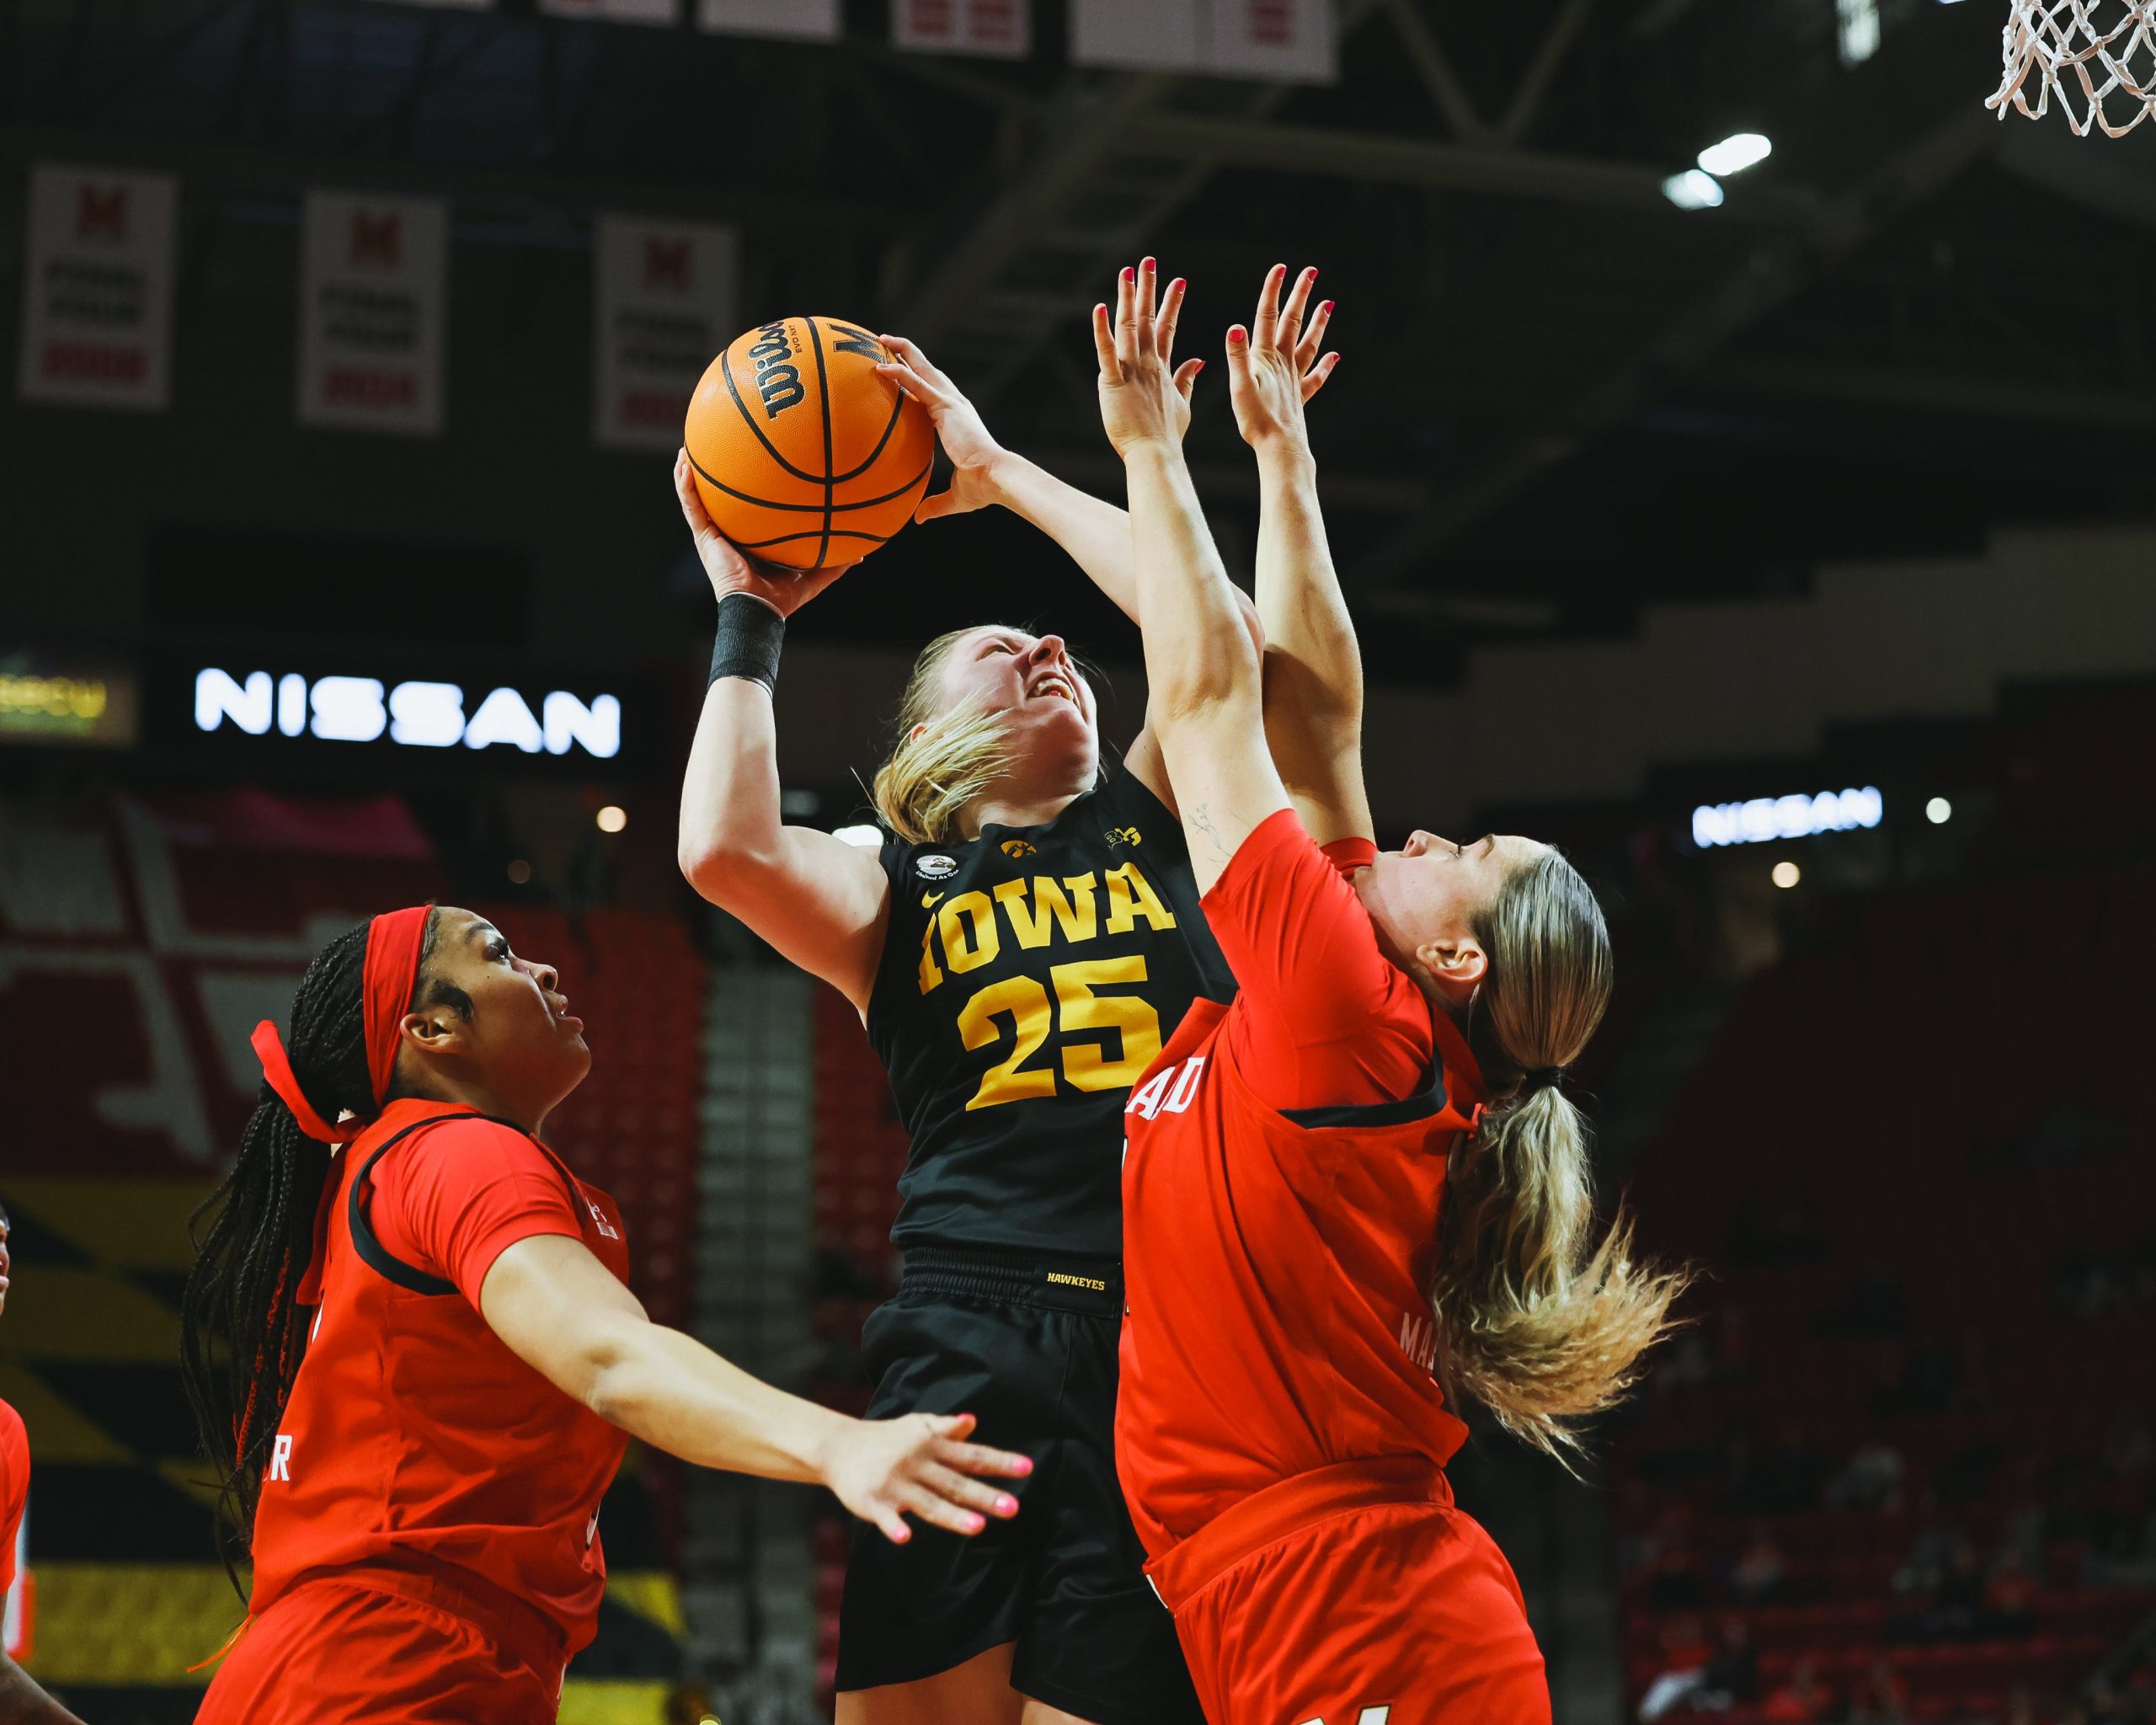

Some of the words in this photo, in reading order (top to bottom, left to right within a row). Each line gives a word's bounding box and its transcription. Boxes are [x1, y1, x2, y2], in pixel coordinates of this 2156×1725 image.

[792, 337, 803, 354] EVO
[195, 667, 622, 759] NISSAN
[1692, 785, 1883, 849] NISSAN
[917, 862, 1177, 996] IOWA
[957, 954, 1163, 1112] 25
[1047, 1272, 1106, 1291] HAWKEYES
